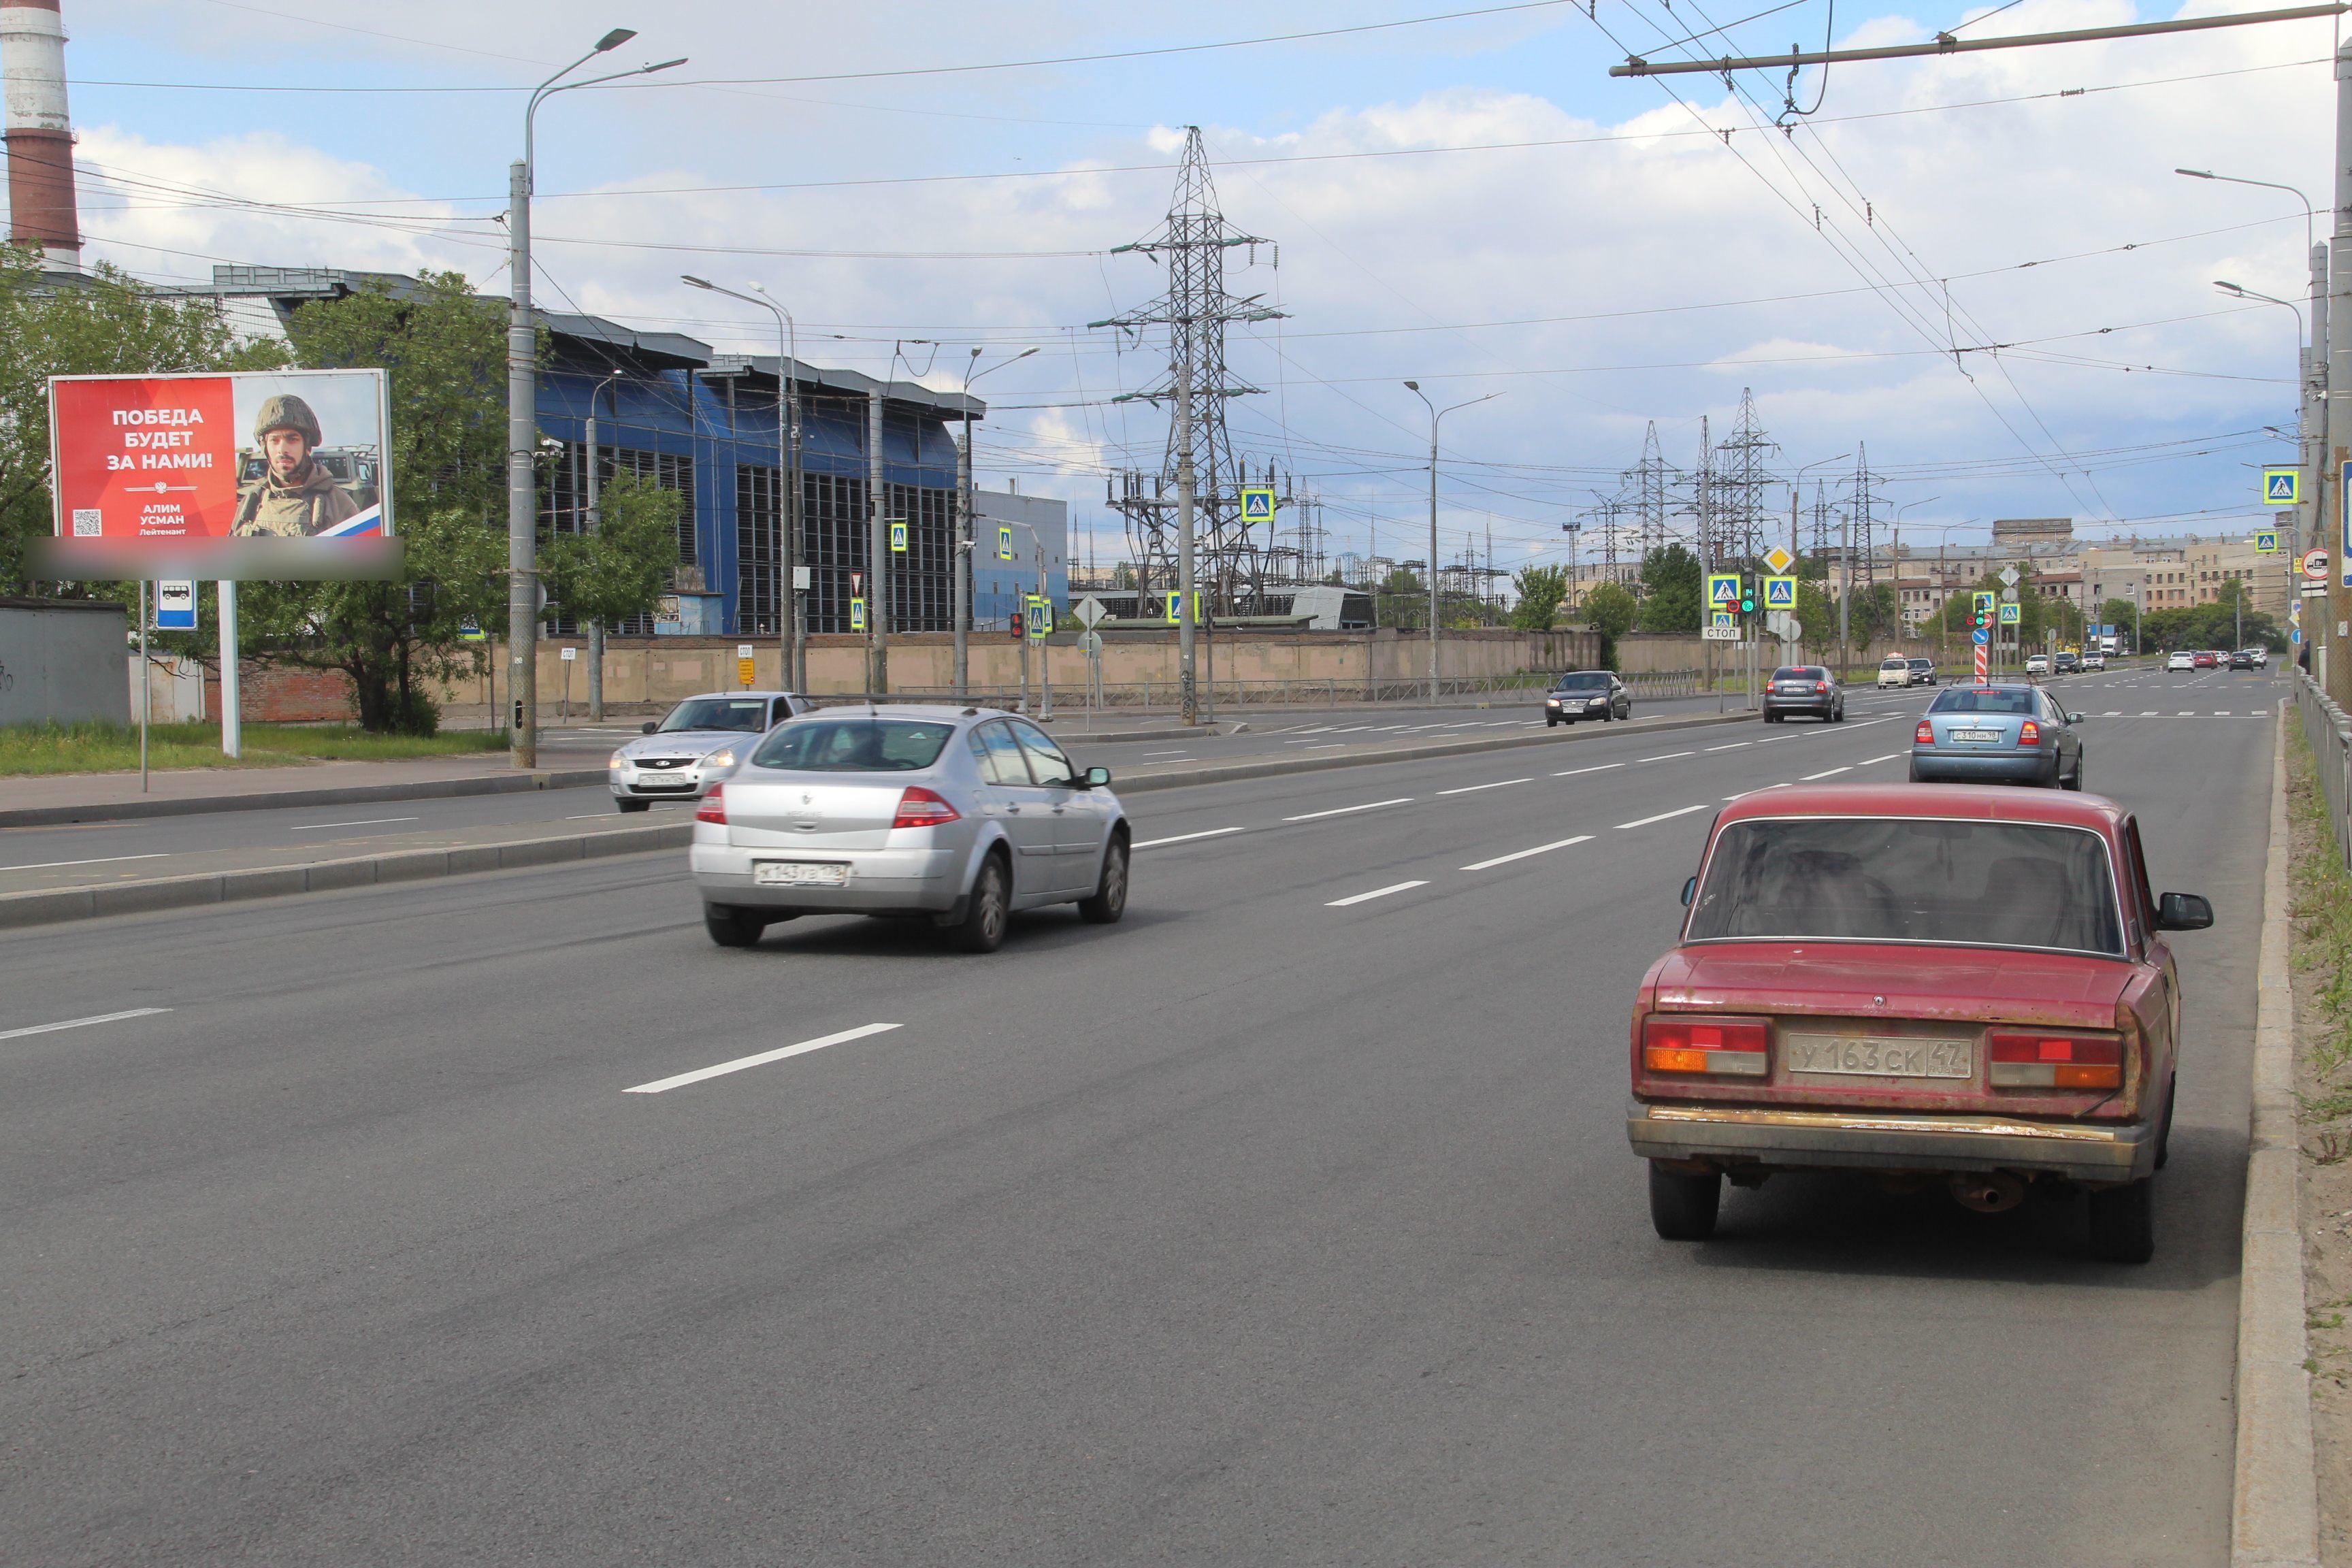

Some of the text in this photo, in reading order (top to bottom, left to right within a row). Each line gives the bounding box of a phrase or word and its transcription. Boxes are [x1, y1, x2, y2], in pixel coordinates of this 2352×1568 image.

[113, 408, 204, 427] ПОБЕДА
[125, 431, 194, 450] БУДЕТ
[107, 453, 213, 470] ЗА НАМИ!
[143, 504, 181, 514] АЛИМ
[140, 515, 185, 525] УСМАН
[140, 528, 186, 536] Лейтенант
[1708, 629, 1735, 638] СТОП
[740, 647, 751, 656] СТОП
[1801, 1040, 1961, 1073] У163СК 47
